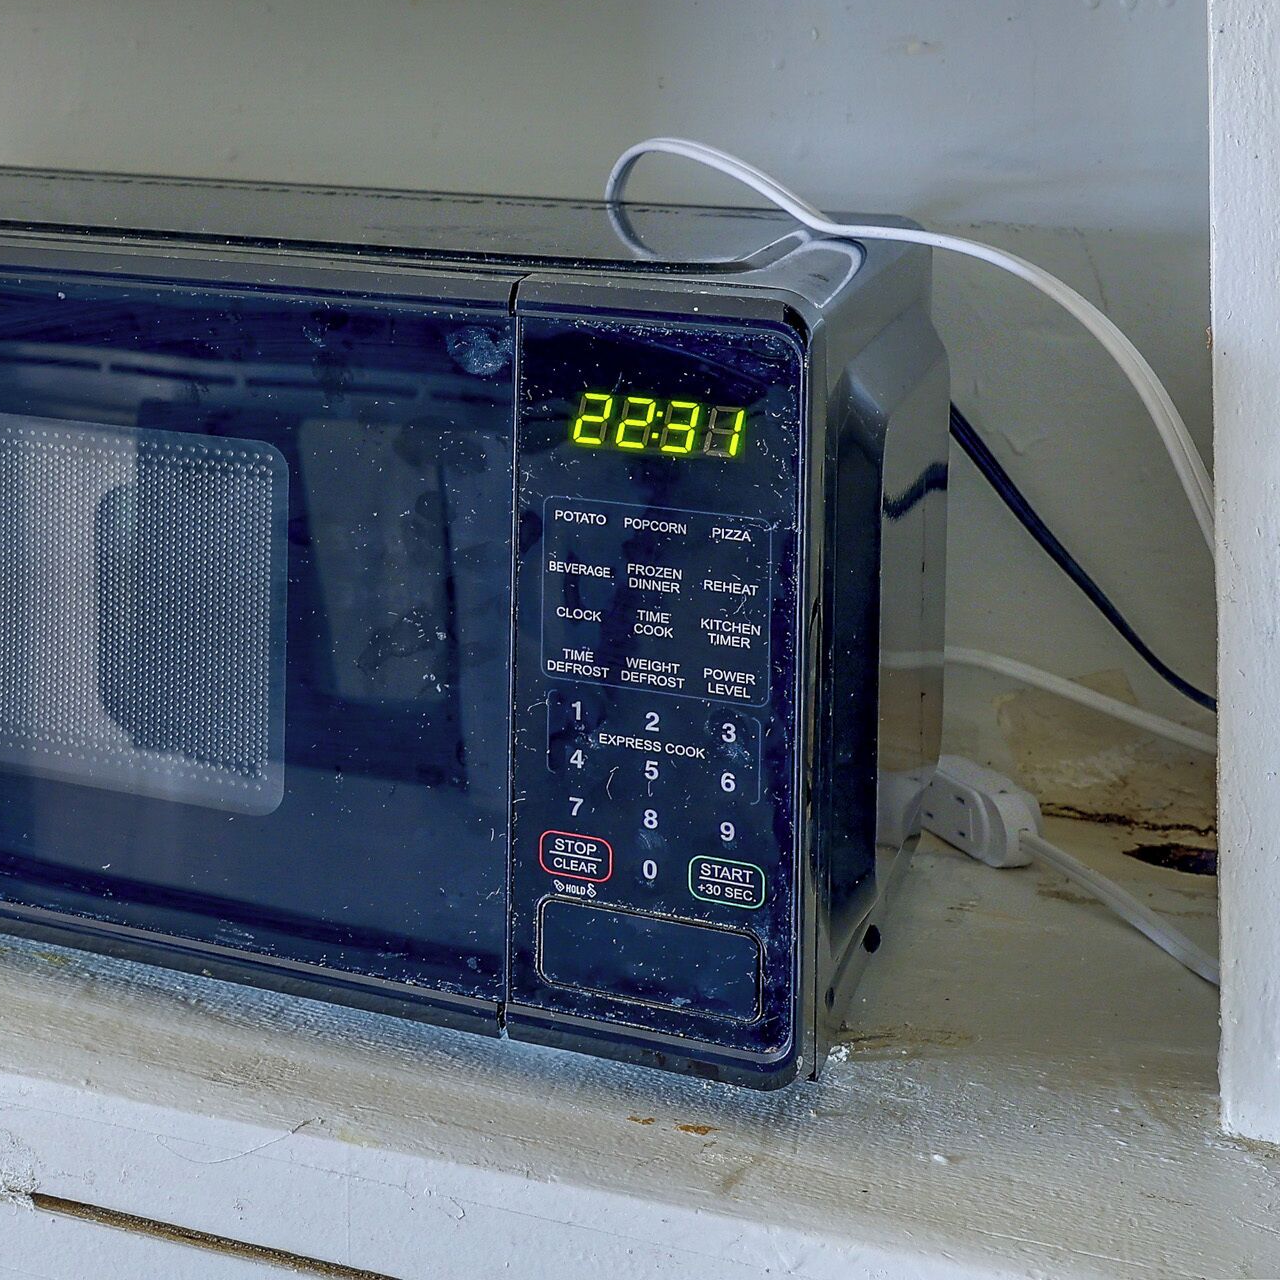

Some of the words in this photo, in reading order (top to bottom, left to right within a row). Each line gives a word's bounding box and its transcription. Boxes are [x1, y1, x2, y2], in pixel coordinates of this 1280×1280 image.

[571, 391, 746, 458] 22:31
[554, 509, 607, 526] POTATO
[624, 517, 687, 535] POPCORN
[712, 527, 751, 542] PIZZA
[549, 560, 611, 578] BEVERAGE
[627, 563, 683, 580] FROZEN
[628, 577, 681, 594] DINNER
[703, 579, 759, 597] REHEAT
[556, 606, 602, 623] CLOCK
[637, 609, 670, 624] TIME
[633, 623, 674, 639] COOK
[700, 617, 761, 637] KITCHEN
[707, 632, 751, 649] TIMER
[562, 648, 594, 663] TIME
[547, 659, 610, 679] DEFROST
[625, 656, 681, 675] WEIGHT
[621, 670, 686, 689] DEFROST
[703, 667, 756, 686] POWER
[707, 682, 751, 699] LEVEL
[570, 701, 582, 721] 1
[645, 711, 660, 732] 2
[721, 722, 737, 743] 3
[598, 732, 662, 753] EXPRESS
[664, 743, 706, 760] COOK
[569, 749, 585, 769] 4
[644, 759, 659, 780] 5
[720, 772, 736, 793] 6
[568, 796, 584, 816] 7
[643, 809, 659, 829] 8
[720, 821, 735, 842] 9
[554, 838, 597, 856] STOP
[552, 857, 598, 875] CLEAR
[642, 859, 658, 880] 0
[700, 862, 754, 883] START
[565, 883, 587, 896] HOLD
[697, 883, 722, 896] +30
[724, 886, 757, 902] SEC.
